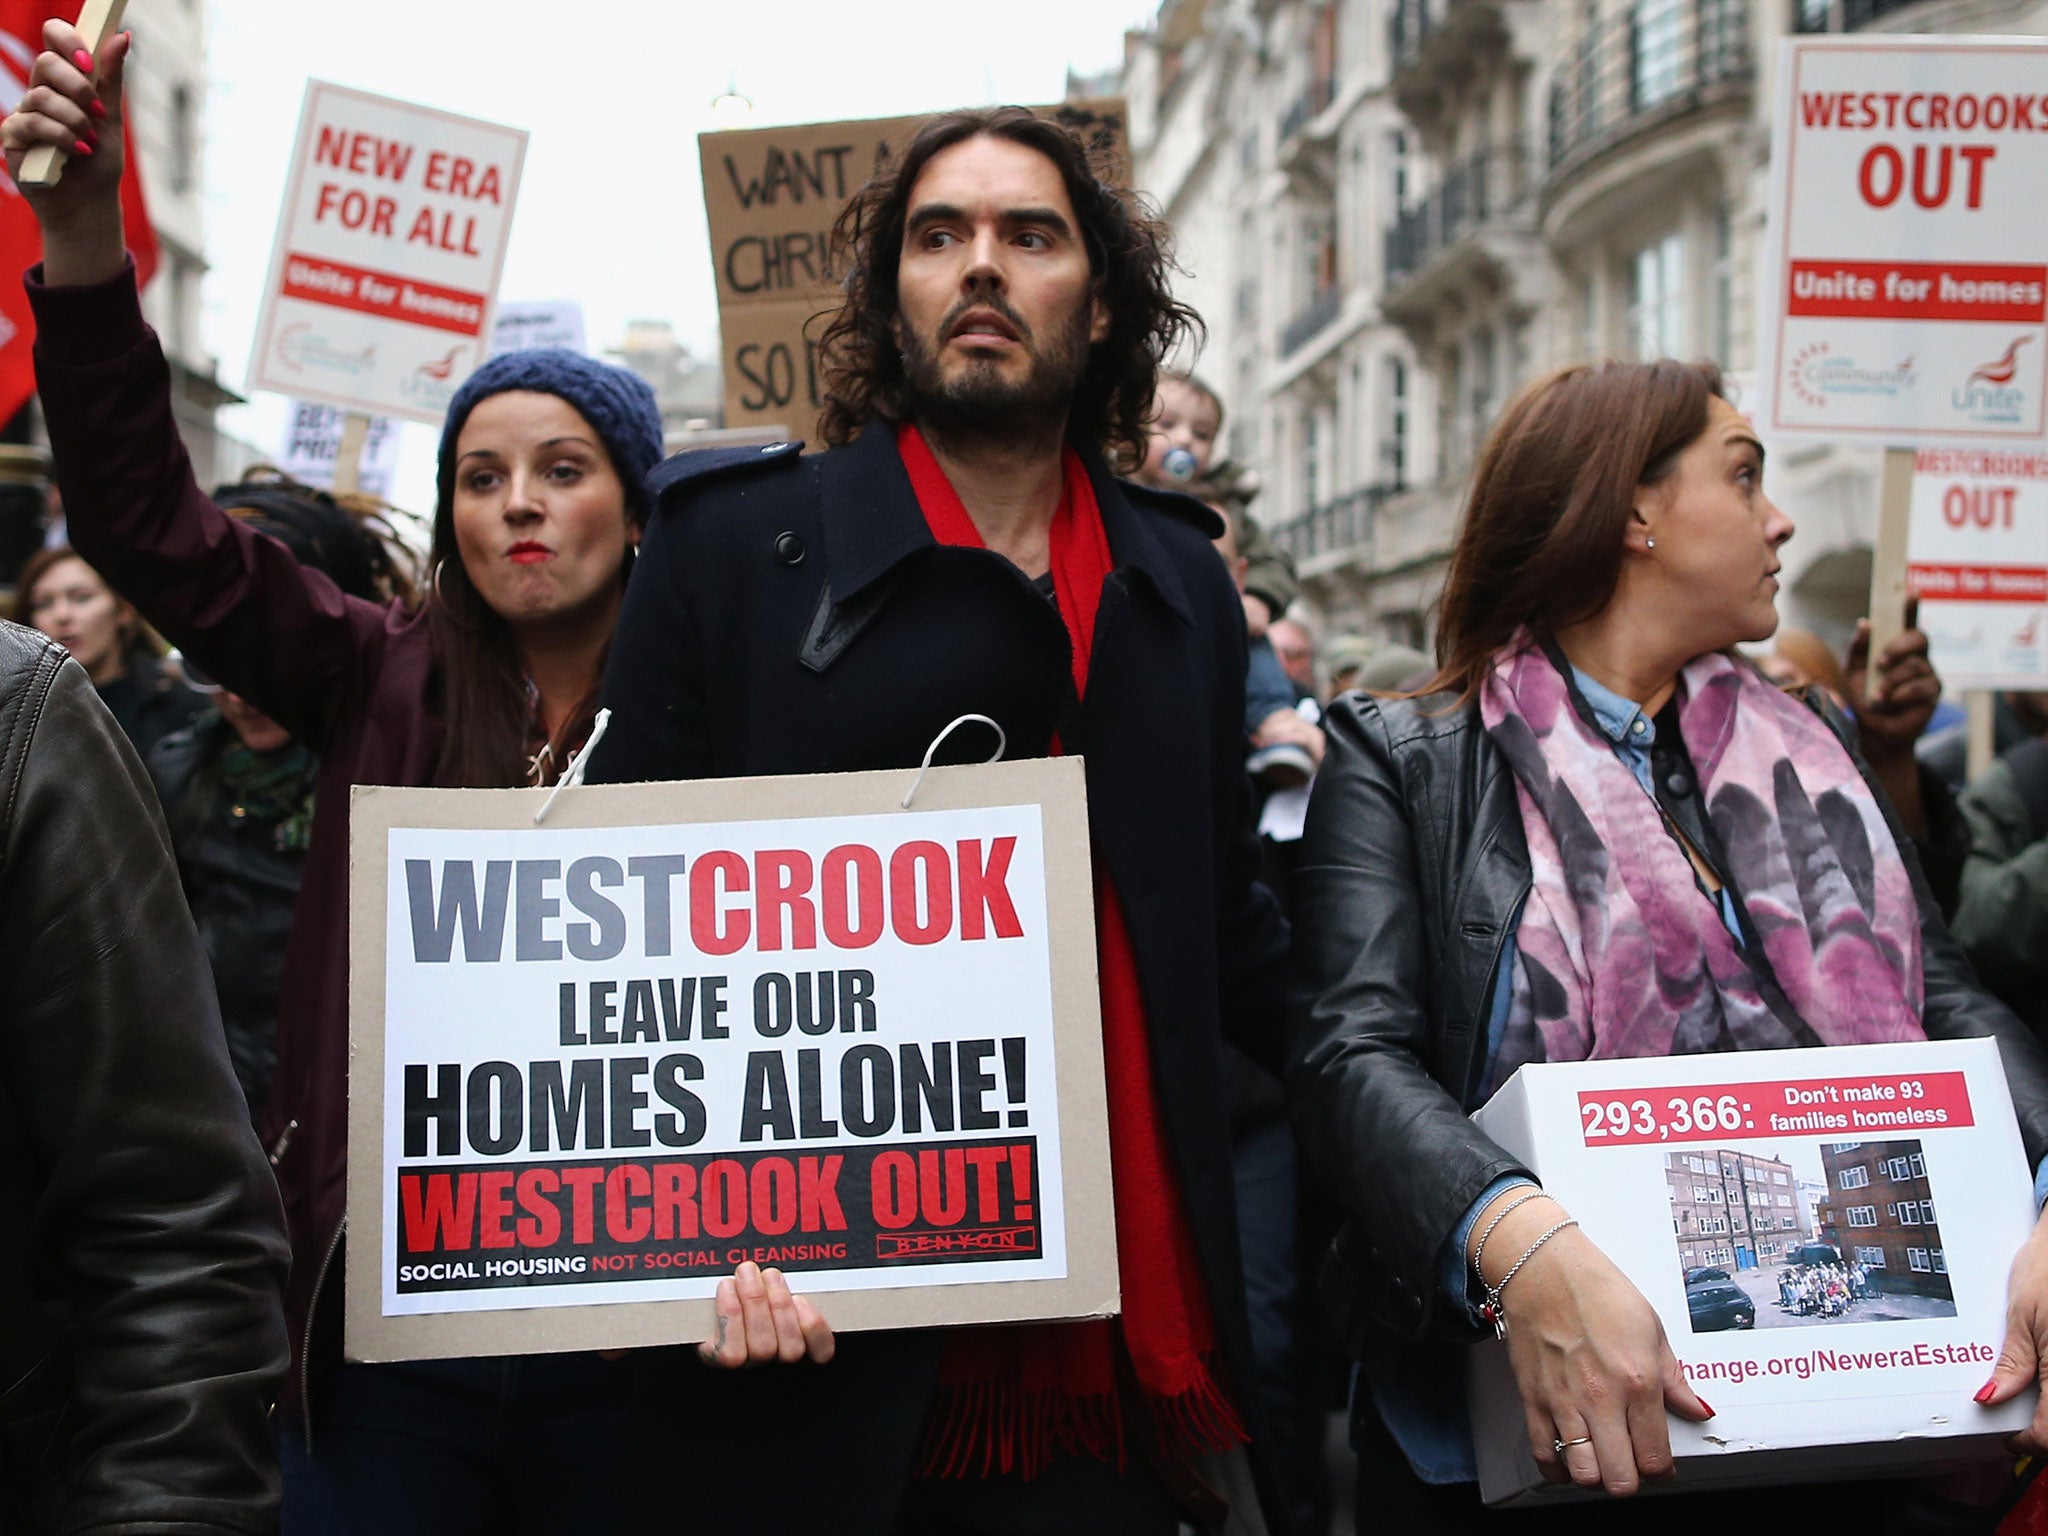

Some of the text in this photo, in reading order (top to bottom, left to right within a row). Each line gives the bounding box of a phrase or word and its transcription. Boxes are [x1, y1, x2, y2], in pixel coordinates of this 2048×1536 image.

[315, 125, 501, 205] NEW ERA
[722, 145, 854, 208] WANT
[1859, 143, 1996, 210] OUT
[315, 183, 481, 257] FOR ALL
[288, 260, 354, 298] Unite
[359, 276, 397, 306] for
[400, 284, 481, 325] homes
[1793, 270, 2043, 306] Unite for homes
[734, 342, 795, 411] SO
[1943, 484, 2017, 530] OUT
[404, 835, 1026, 963] WESTCROOK
[558, 968, 877, 1047] LEAVE OUR
[403, 1036, 1029, 1158] HOMES ALONE!
[1580, 1094, 1755, 1142] 293,366:
[1769, 1105, 1948, 1133] families homeless
[1843, 1082, 1897, 1103] make
[1898, 1080, 1924, 1099] 93
[399, 1144, 1033, 1253] WESTCROOK OUT!
[400, 1242, 848, 1282] SOCIAL HOUSING NOT SOCIAL CLEANSING
[896, 1233, 1015, 1253] BENYON
[1679, 1341, 1995, 1384] hange.org/NeweraEstate
